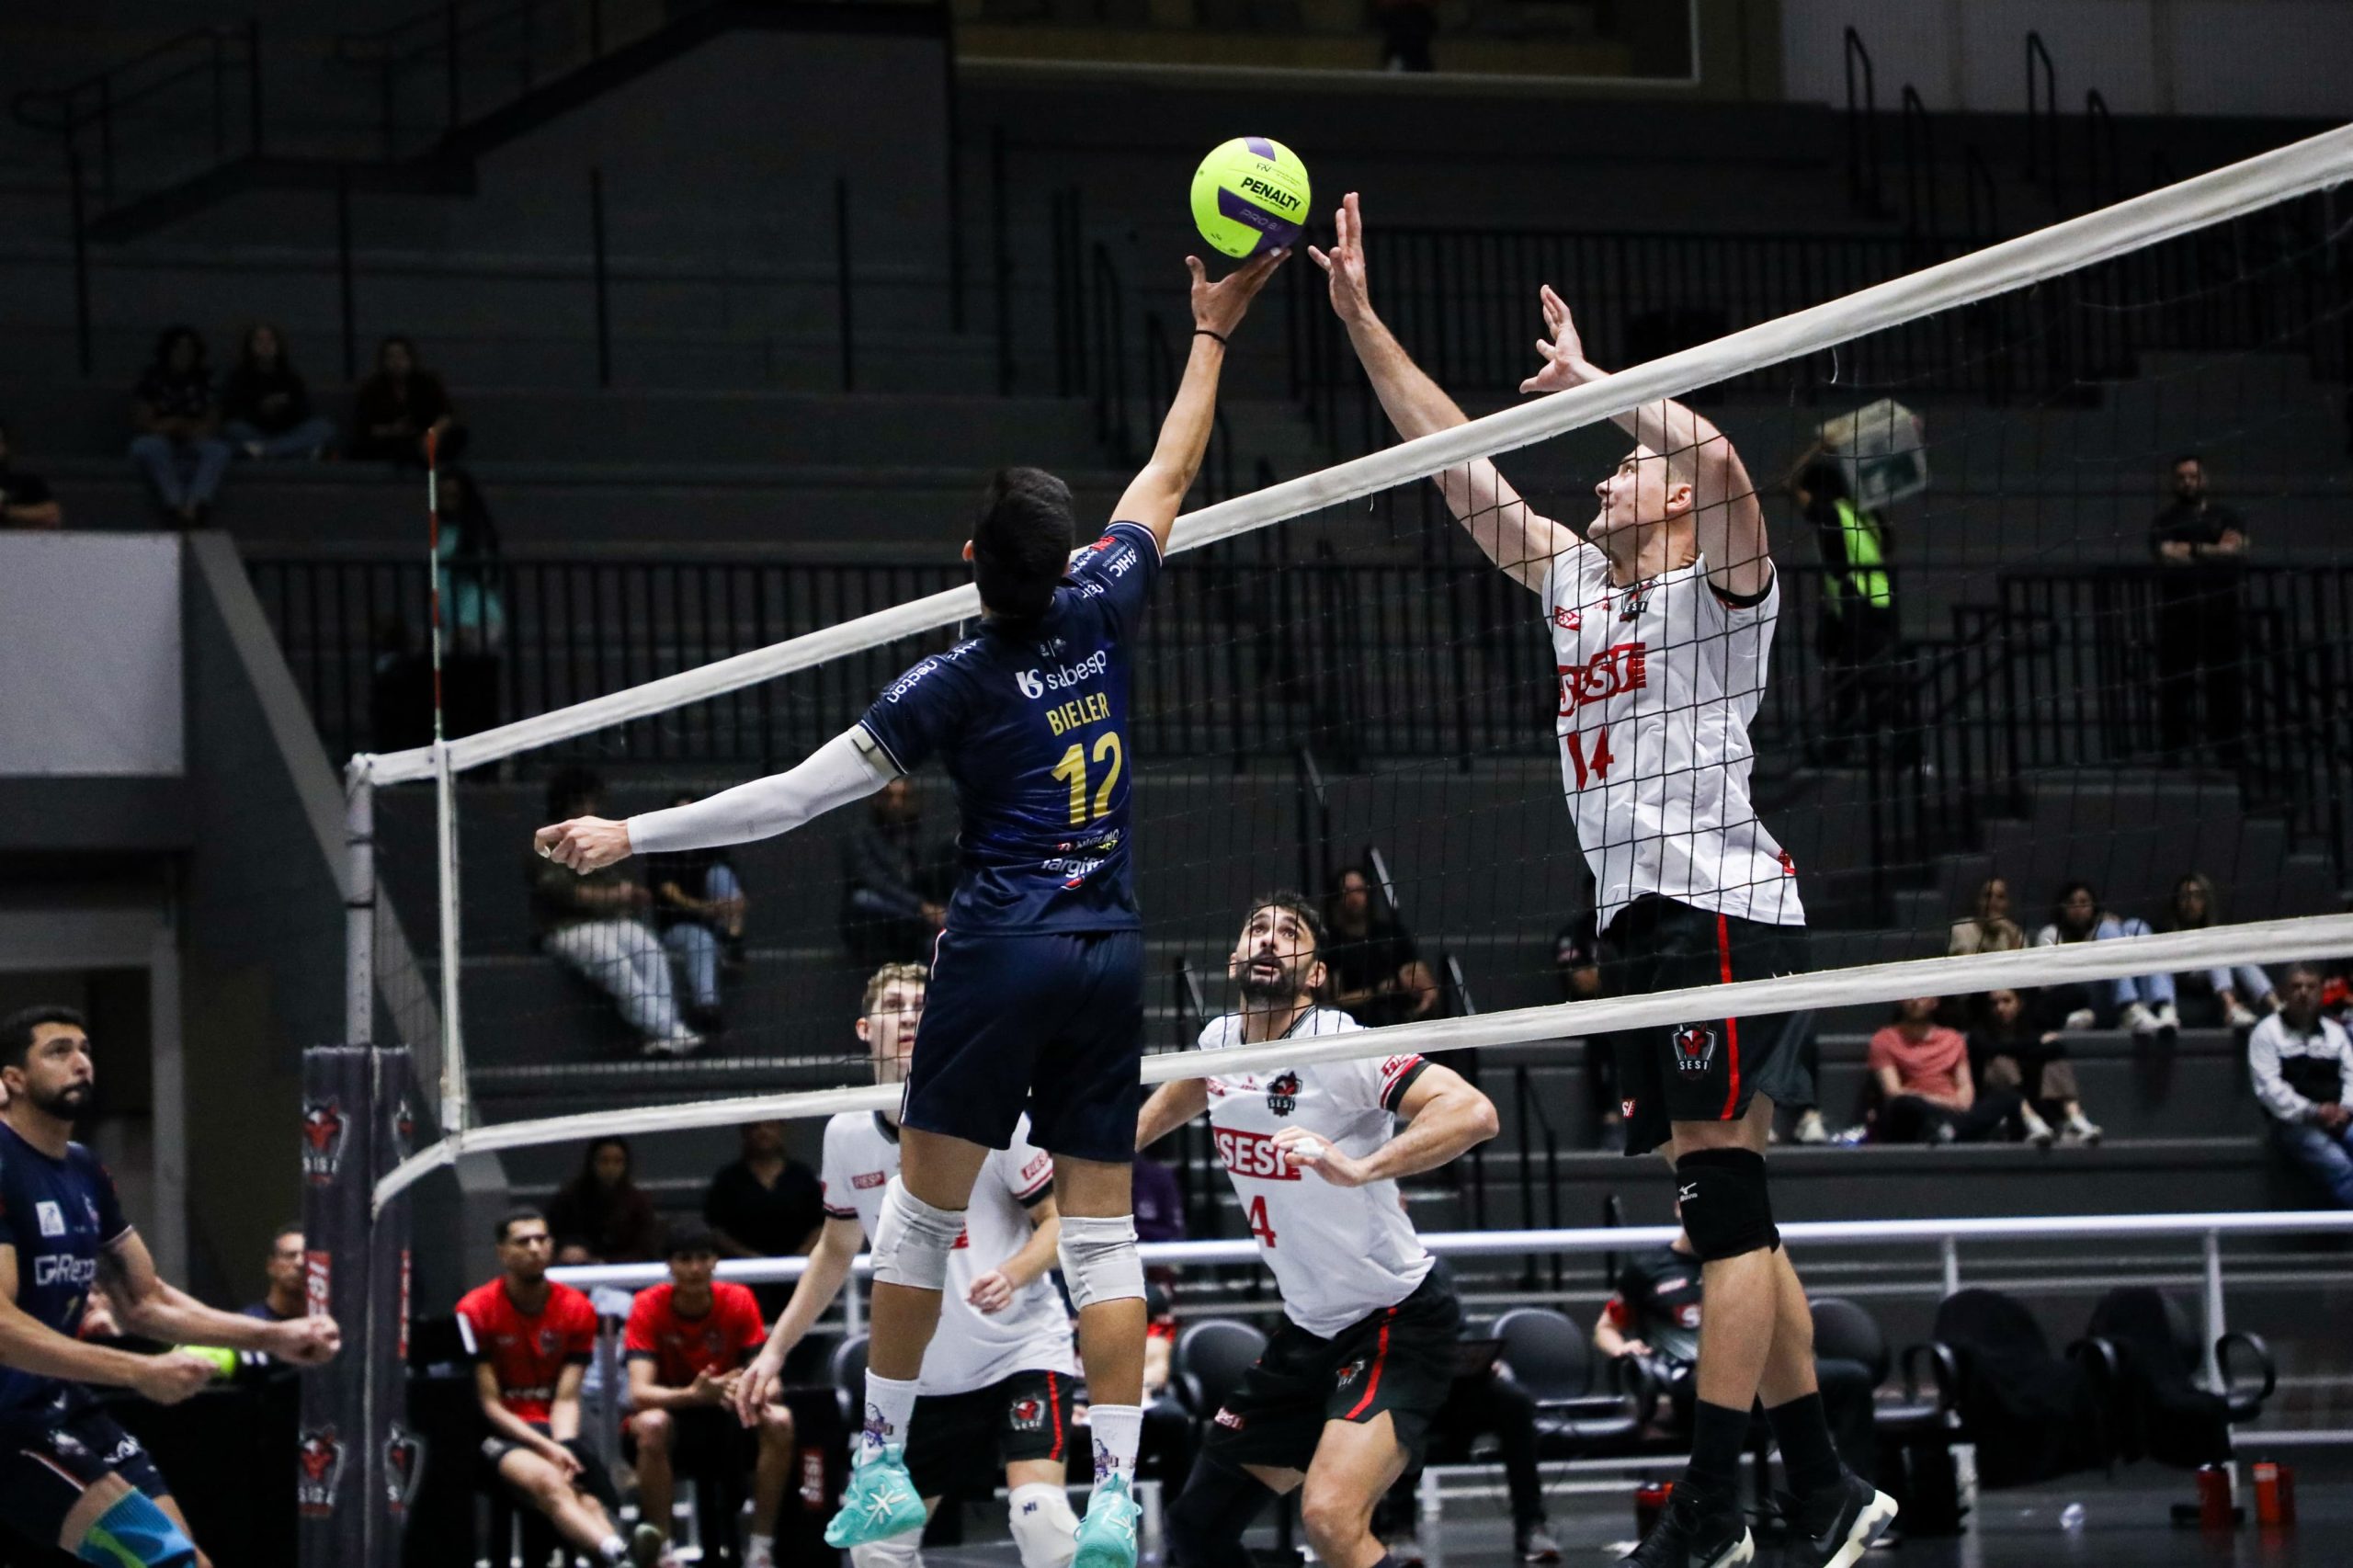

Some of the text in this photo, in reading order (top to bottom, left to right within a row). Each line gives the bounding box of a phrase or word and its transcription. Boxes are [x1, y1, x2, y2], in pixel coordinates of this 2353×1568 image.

[1240, 176, 1302, 211] PENALTY
[1046, 650, 1107, 690] sabesp
[1046, 692, 1110, 736] BIELER
[1051, 731, 1122, 825] 12
[1567, 725, 1614, 792] 14
[1679, 1060, 1708, 1071] SESI
[1218, 1132, 1287, 1176] SESI
[1248, 1195, 1278, 1248] 4
